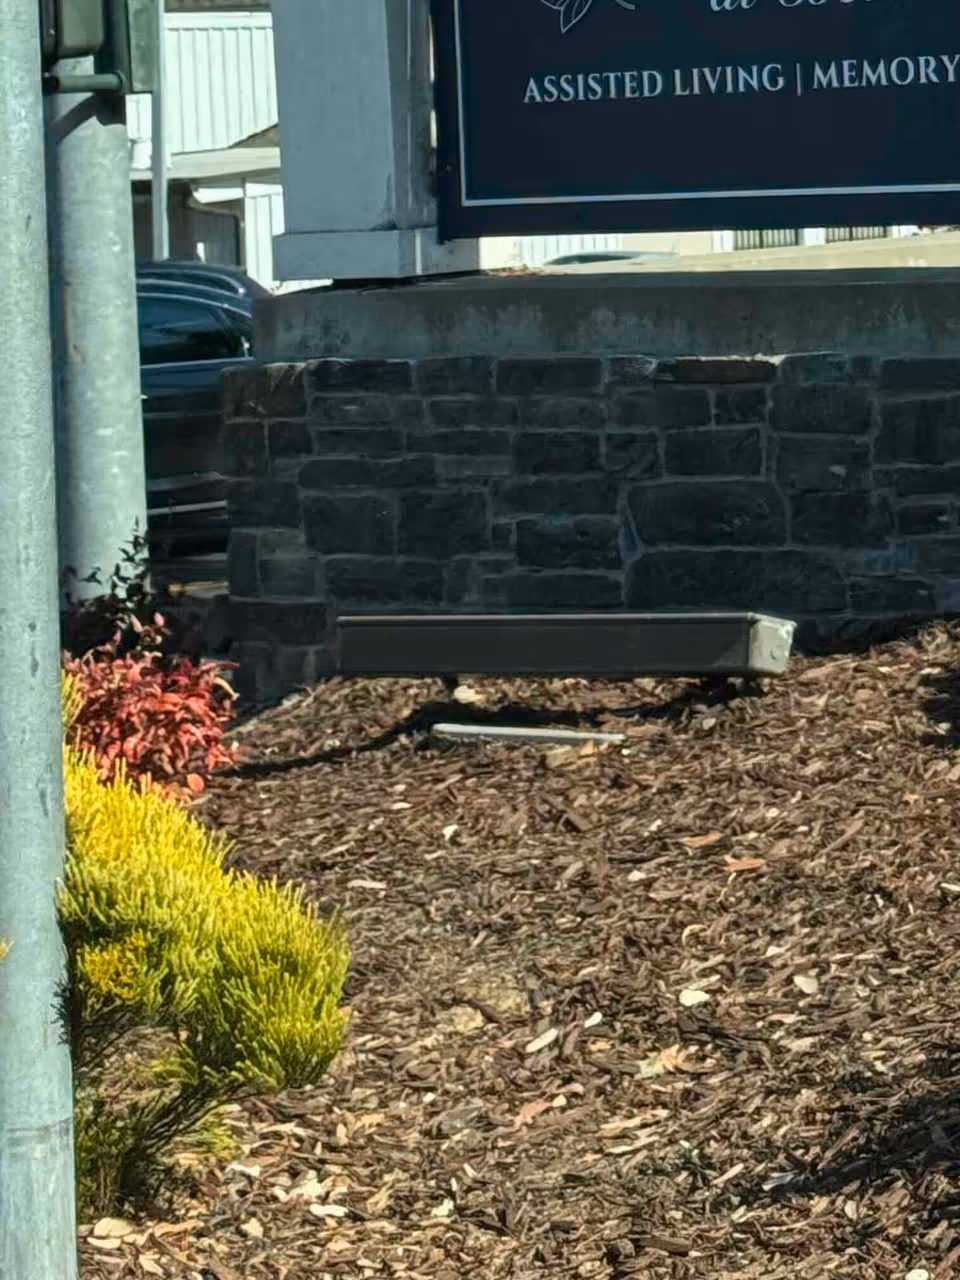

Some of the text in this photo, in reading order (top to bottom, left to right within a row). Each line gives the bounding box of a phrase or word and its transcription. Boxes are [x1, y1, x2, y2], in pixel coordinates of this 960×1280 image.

[523, 70, 663, 104] ASSISTED
[673, 63, 785, 97] LIVING
[812, 54, 960, 90] MEMORY
